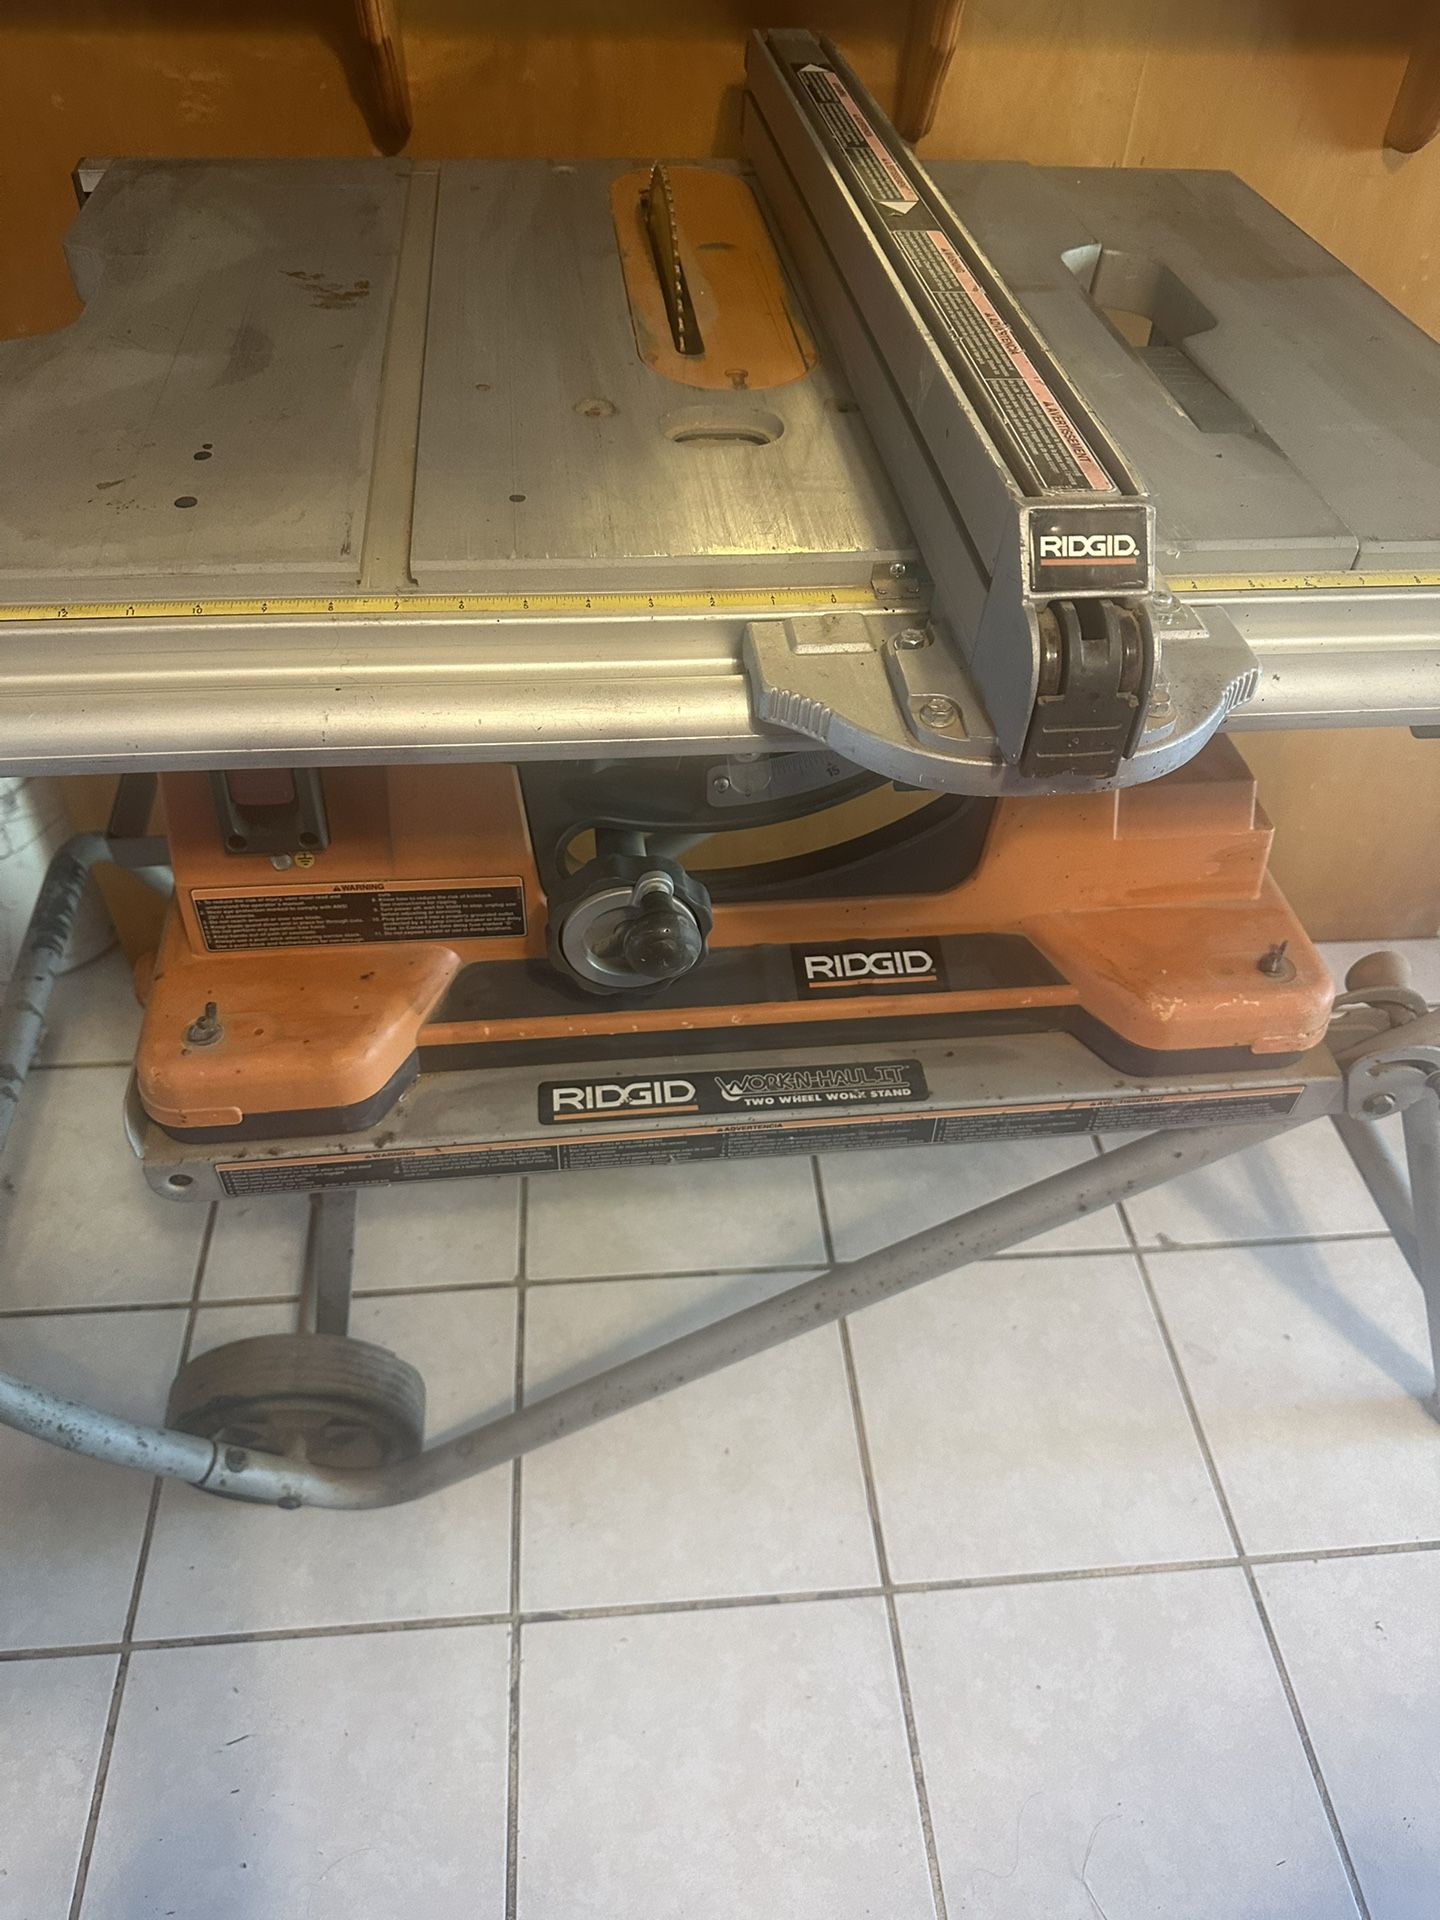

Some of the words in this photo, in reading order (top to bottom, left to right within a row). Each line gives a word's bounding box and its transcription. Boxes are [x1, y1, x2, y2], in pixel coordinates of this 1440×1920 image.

[1048, 402, 1092, 463] AVERTISSEMENT
[826, 766, 841, 777] 15
[341, 883, 385, 891] WARNING
[804, 950, 933, 979] RIDGID
[552, 1080, 697, 1112] RIDGID
[744, 1096, 774, 1106] TWO
[779, 1093, 822, 1104] WHEEL
[870, 1088, 912, 1098] STAND
[724, 1123, 783, 1132] ADVERTENCIA
